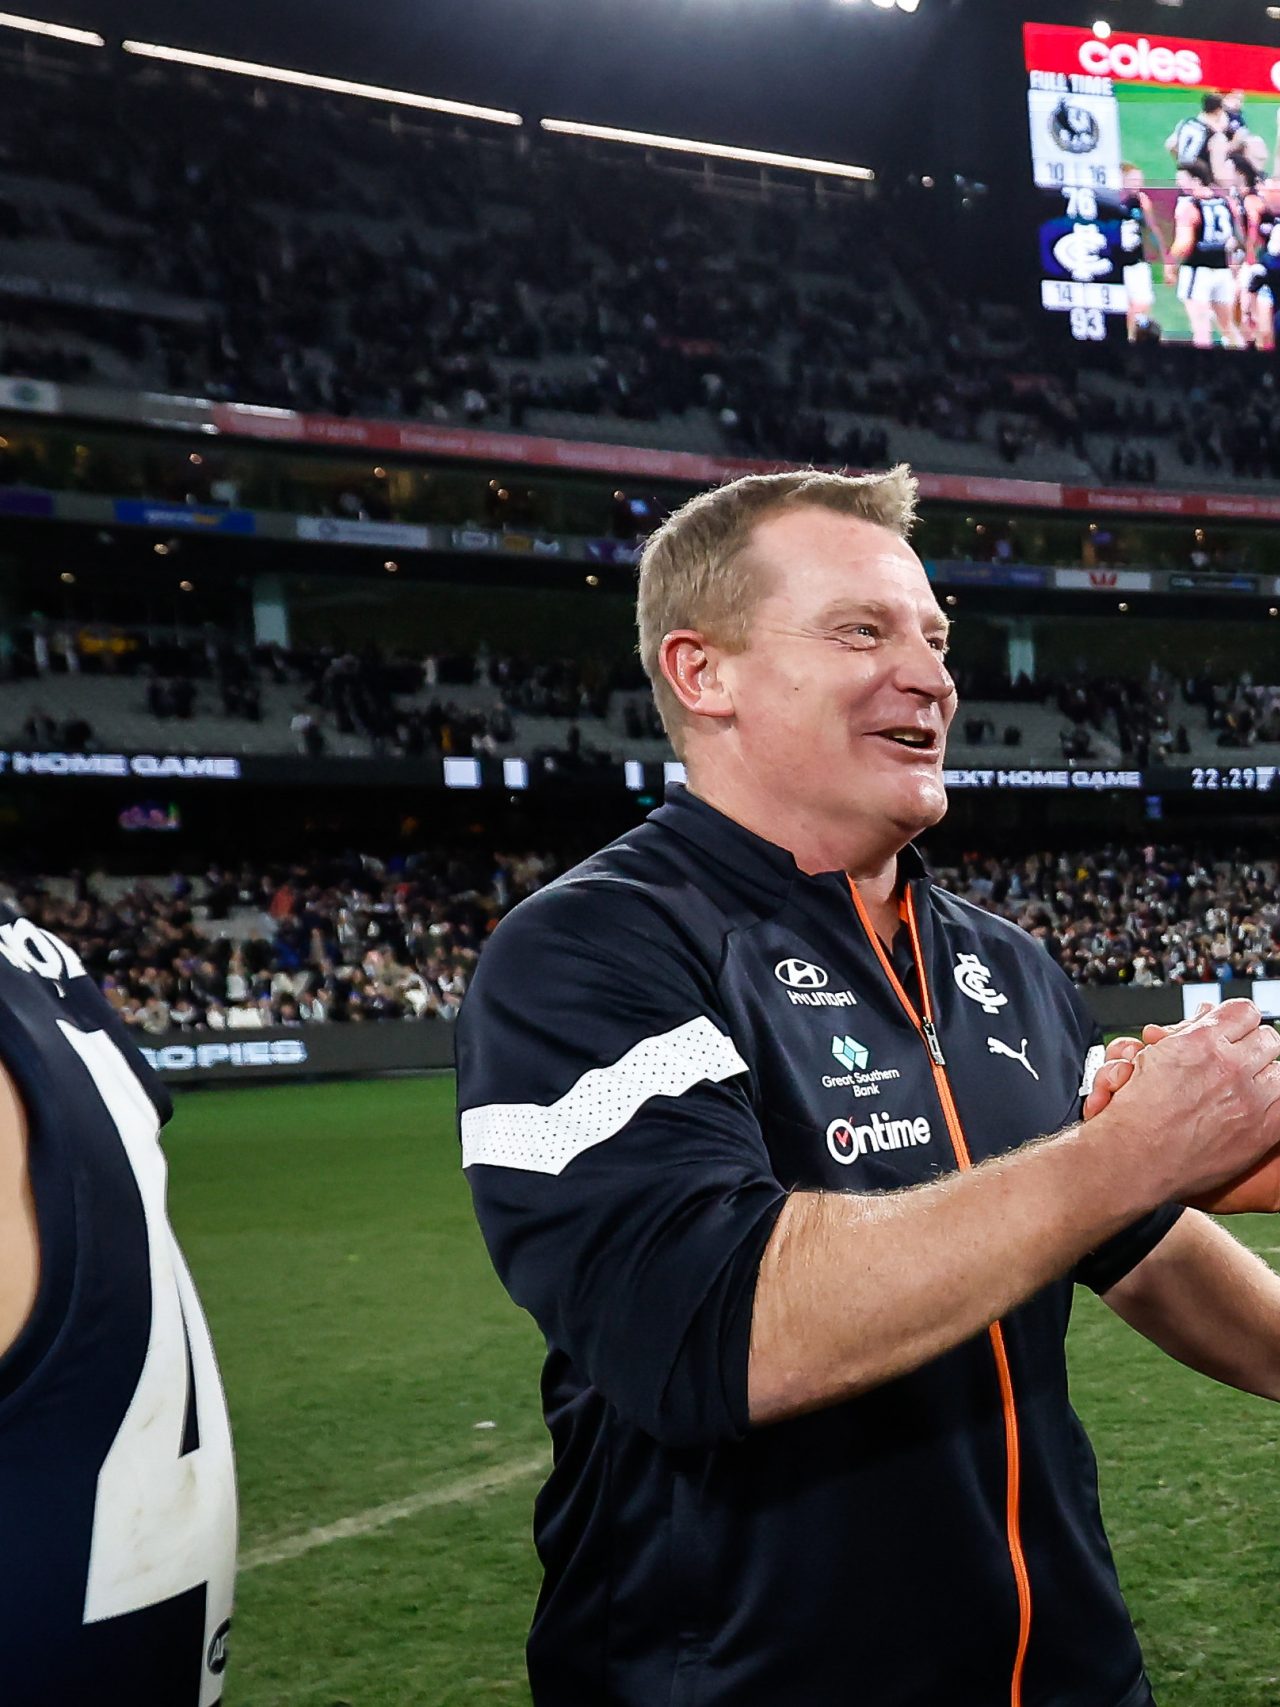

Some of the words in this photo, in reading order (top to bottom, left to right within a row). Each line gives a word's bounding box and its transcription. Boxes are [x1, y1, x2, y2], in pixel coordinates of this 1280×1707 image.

[1078, 37, 1203, 84] coles
[1069, 73, 1113, 97] TIME
[1048, 162, 1065, 182] 10
[1089, 164, 1107, 186] 16
[1062, 187, 1098, 221] 76
[1055, 283, 1073, 303] 14
[1070, 307, 1106, 341] 93
[12, 752, 128, 777] HOME
[130, 755, 240, 779] GAME
[997, 770, 1069, 787] HOME
[1071, 771, 1140, 788] GAME
[786, 989, 858, 1007] HYUNDAI
[821, 1074, 856, 1089] Great
[853, 1068, 901, 1084] Southern
[852, 1082, 881, 1098] Bank
[825, 1111, 932, 1165] Ontime
